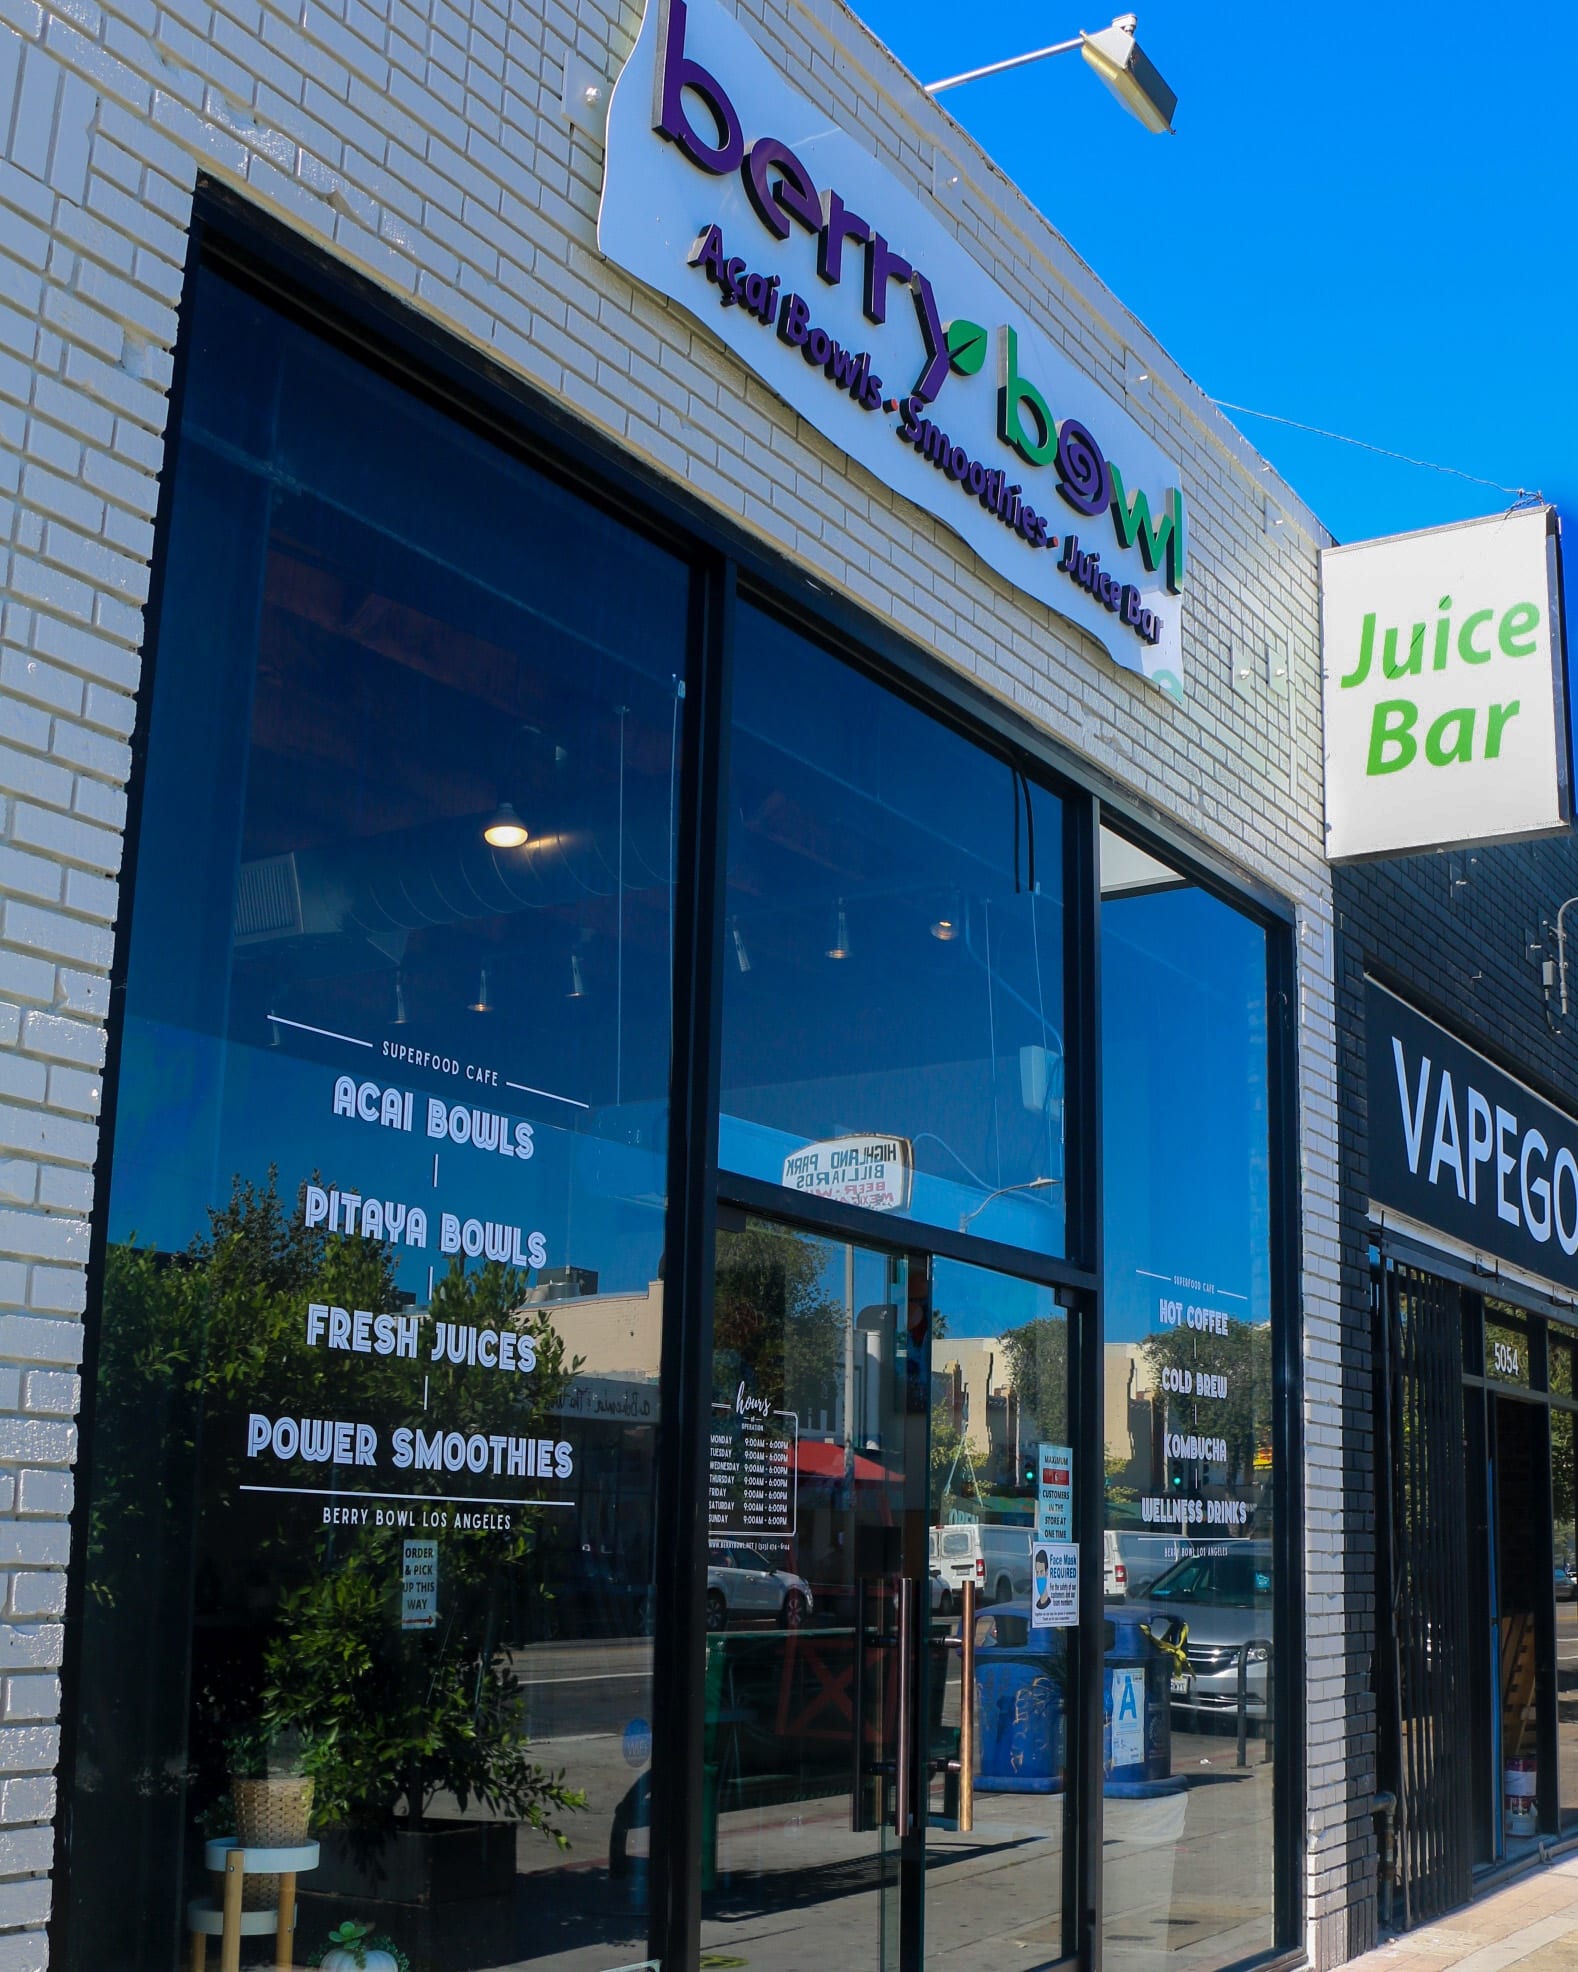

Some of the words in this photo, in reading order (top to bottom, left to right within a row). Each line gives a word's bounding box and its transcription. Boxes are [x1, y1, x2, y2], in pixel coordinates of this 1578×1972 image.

[652, 0, 951, 403] berry
[998, 324, 1183, 595] bowl
[776, 292, 883, 411] Bowls
[896, 396, 1048, 548] Smoothies
[1057, 535, 1122, 613] Juice
[1120, 584, 1164, 645] Bar
[1341, 595, 1540, 688] Juice
[1366, 699, 1520, 775] Bar
[382, 1041, 459, 1075] SUPERFOOD
[466, 1065, 499, 1087] CAFE
[333, 1075, 413, 1132] ACAI
[427, 1097, 534, 1160] BOWLS
[305, 1185, 427, 1248] PITAYA
[440, 1212, 547, 1268] BOWLS
[1174, 1275, 1201, 1290] SUPERFOOD
[1203, 1282, 1215, 1294] CAFE
[1159, 1298, 1183, 1326] HOT
[1186, 1305, 1229, 1336] COFFEE
[306, 1303, 419, 1358] FRESH
[431, 1322, 537, 1374] JUICES
[1494, 1342, 1519, 1376] 5054
[1162, 1366, 1192, 1395] COLD
[1196, 1371, 1228, 1400] BREW
[736, 1381, 771, 1417] hours
[247, 1413, 377, 1466] POWER
[392, 1427, 573, 1479] SMOOTHIES
[710, 1434, 732, 1445] MONDAY
[744, 1438, 765, 1448] 9:00AM
[769, 1440, 789, 1450] 6:00PM
[1163, 1432, 1227, 1462] KOMBUCHA
[710, 1447, 732, 1458] TUESDAY
[744, 1451, 765, 1461] 9:00AM
[769, 1453, 789, 1462] 6:00PM
[1045, 1455, 1068, 1465] MAXIMUM
[709, 1461, 740, 1471] WEDNESDAY
[744, 1464, 765, 1473] 9:00AM
[768, 1465, 788, 1475] 6:00PM
[709, 1474, 735, 1484] THURSDAY
[743, 1476, 764, 1486] 9:00AM
[768, 1478, 788, 1488] 6:00PM
[708, 1487, 727, 1497] FRIDAY
[743, 1489, 764, 1499] 9:00AM
[768, 1490, 788, 1500] 6:00PM
[1043, 1490, 1069, 1499] CUSTOMERS
[708, 1500, 735, 1511] SATURDAY
[743, 1502, 764, 1512] 9:00AM
[768, 1503, 788, 1513] 6:00PM
[1141, 1497, 1204, 1524] WELLNESS
[1207, 1500, 1247, 1524] DRINKS
[323, 1507, 368, 1525] BERRY
[376, 1509, 415, 1527] BOWL
[423, 1511, 447, 1528] LOS
[454, 1513, 511, 1530] ANGELES
[708, 1514, 729, 1523] SUNDAY
[743, 1516, 764, 1525] 9:00AM
[767, 1516, 787, 1525] 6:00PM
[1045, 1516, 1060, 1525] STORE
[1060, 1517, 1066, 1525] AT
[1045, 1529, 1055, 1538] ONE
[1055, 1530, 1067, 1539] TIME
[405, 1547, 433, 1558] ORDER
[1050, 1554, 1062, 1565] Face
[1063, 1554, 1077, 1565] Mask
[1207, 1547, 1228, 1556] ANGELES
[405, 1565, 411, 1575] &
[414, 1565, 432, 1576] PICK
[1050, 1568, 1076, 1578] REQUIRED
[403, 1582, 414, 1592] UP
[416, 1582, 435, 1592] THIS
[408, 1600, 427, 1609] WAY
[1119, 1675, 1137, 1720] A
